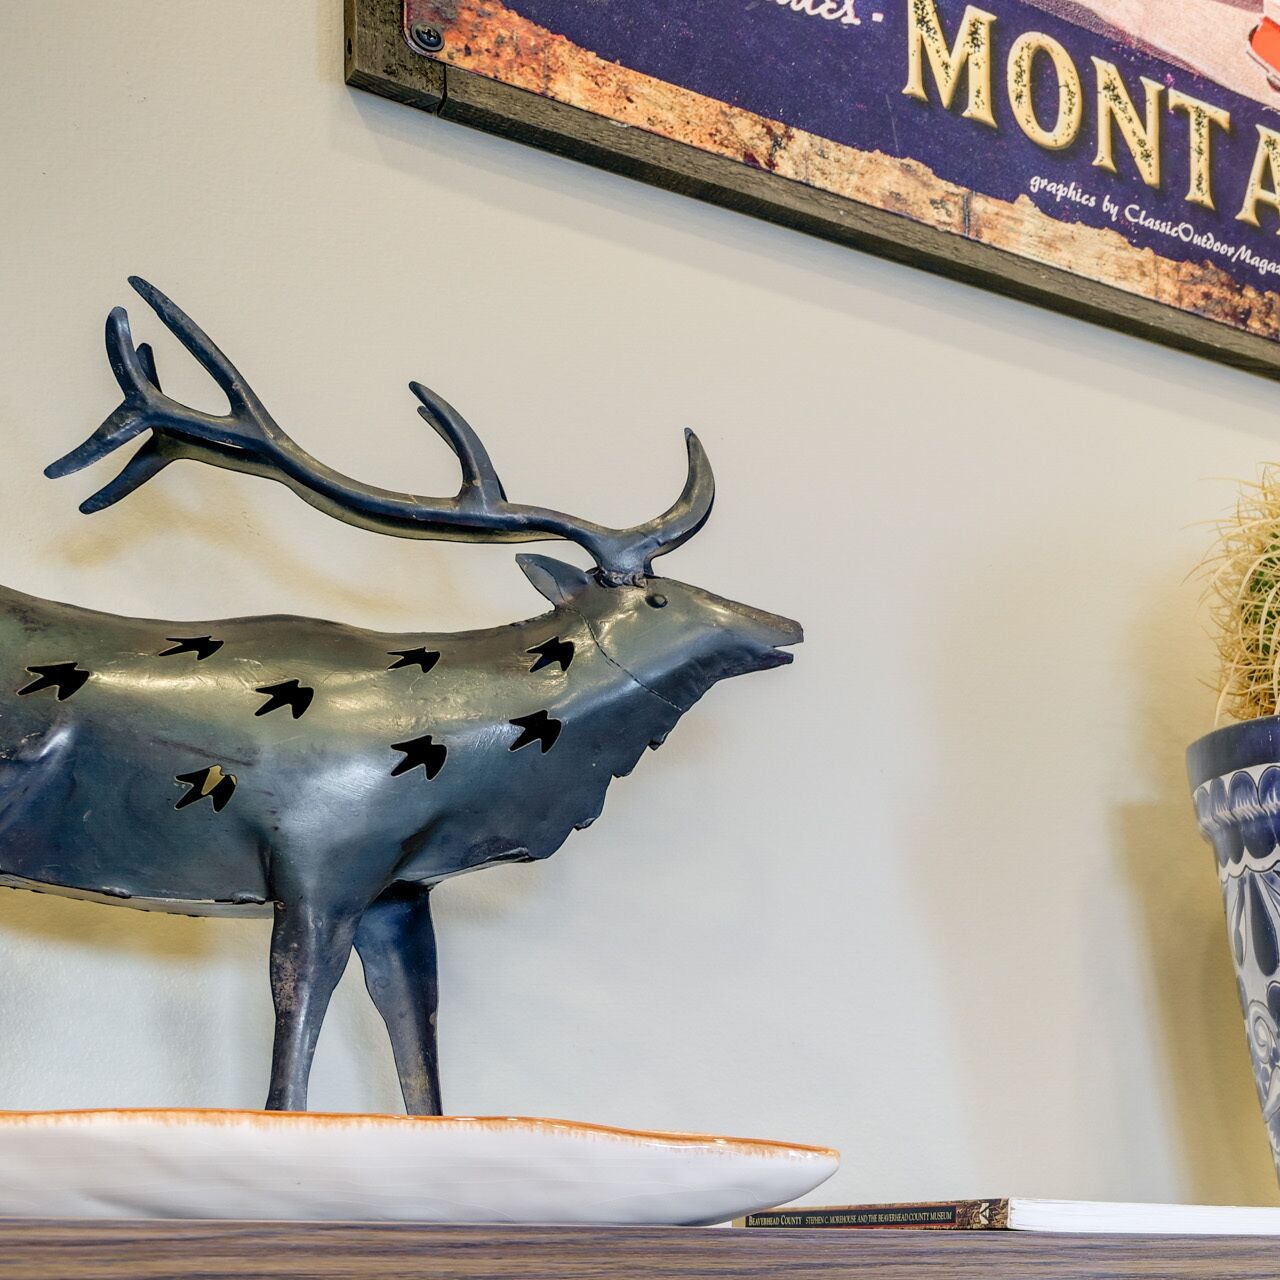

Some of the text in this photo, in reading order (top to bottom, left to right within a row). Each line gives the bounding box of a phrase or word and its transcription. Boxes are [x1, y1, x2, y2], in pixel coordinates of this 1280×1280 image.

[1030, 175, 1096, 208] graphics
[1102, 194, 1119, 221] by
[780, 1215, 802, 1225] COUNTY
[930, 1211, 952, 1220] MUSEUM
